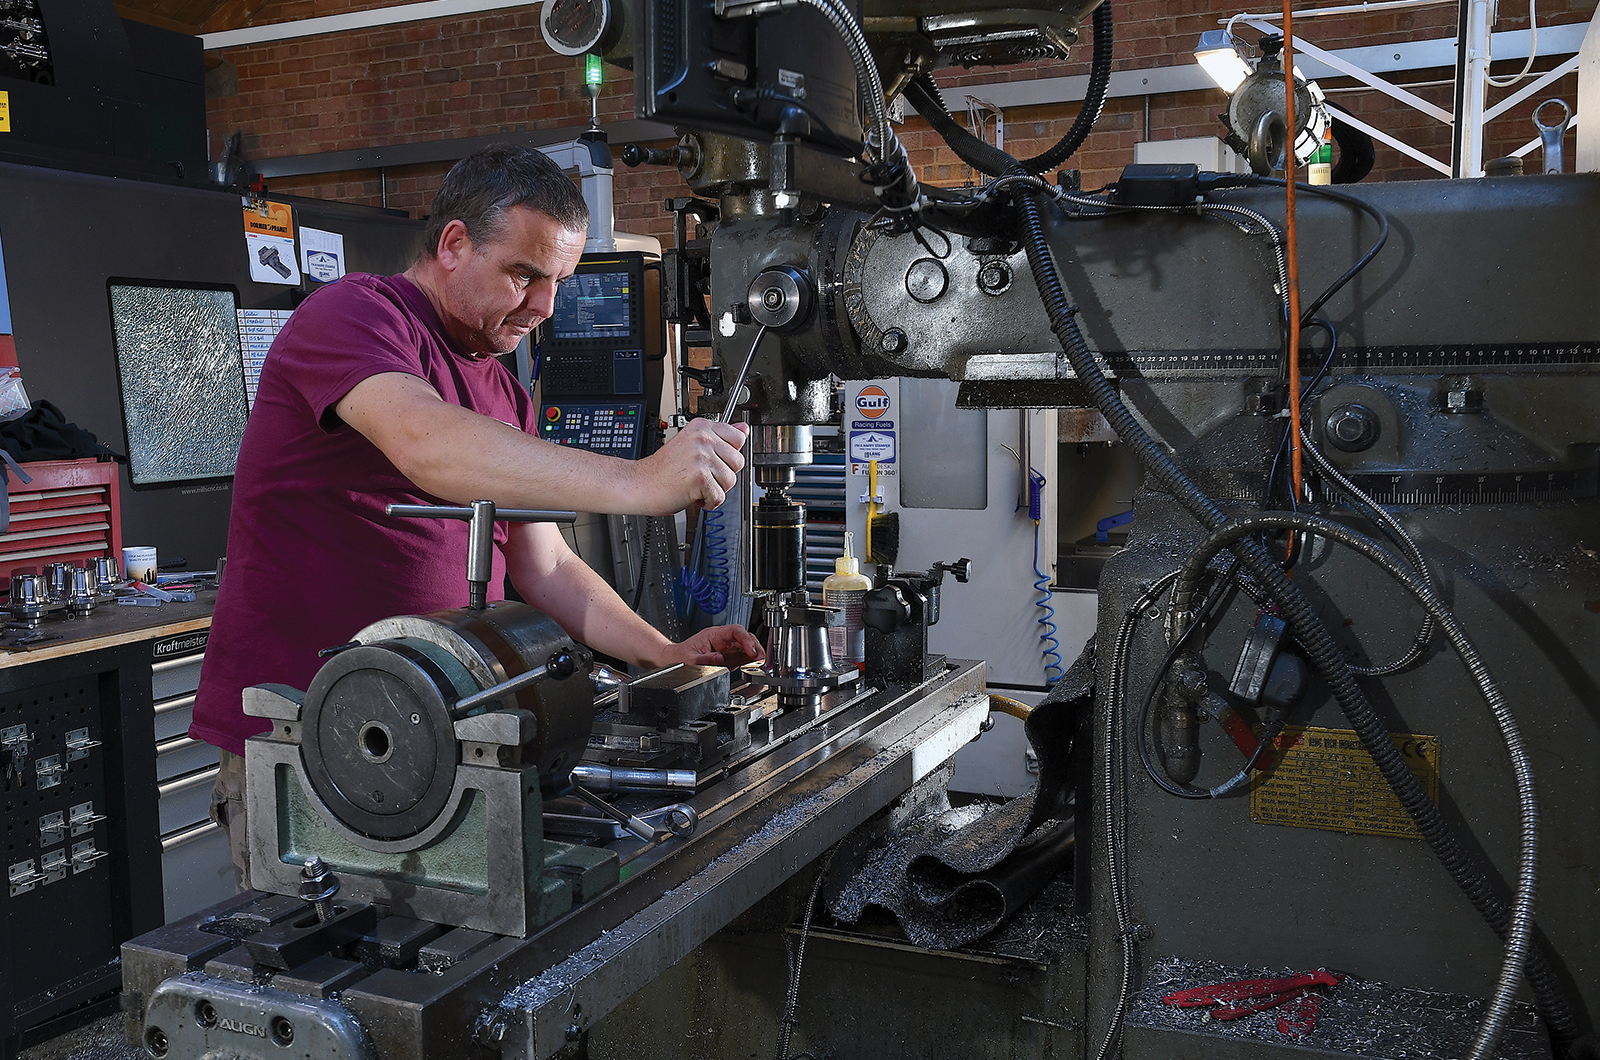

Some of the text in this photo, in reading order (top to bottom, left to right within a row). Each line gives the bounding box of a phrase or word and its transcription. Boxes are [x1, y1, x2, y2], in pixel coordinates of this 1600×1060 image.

[857, 397, 889, 408] Gulf
[157, 636, 207, 654] Kraftmeister
[590, 735, 605, 744] 25
[1402, 740, 1427, 759] CE
[220, 1018, 267, 1038] ALIGN
